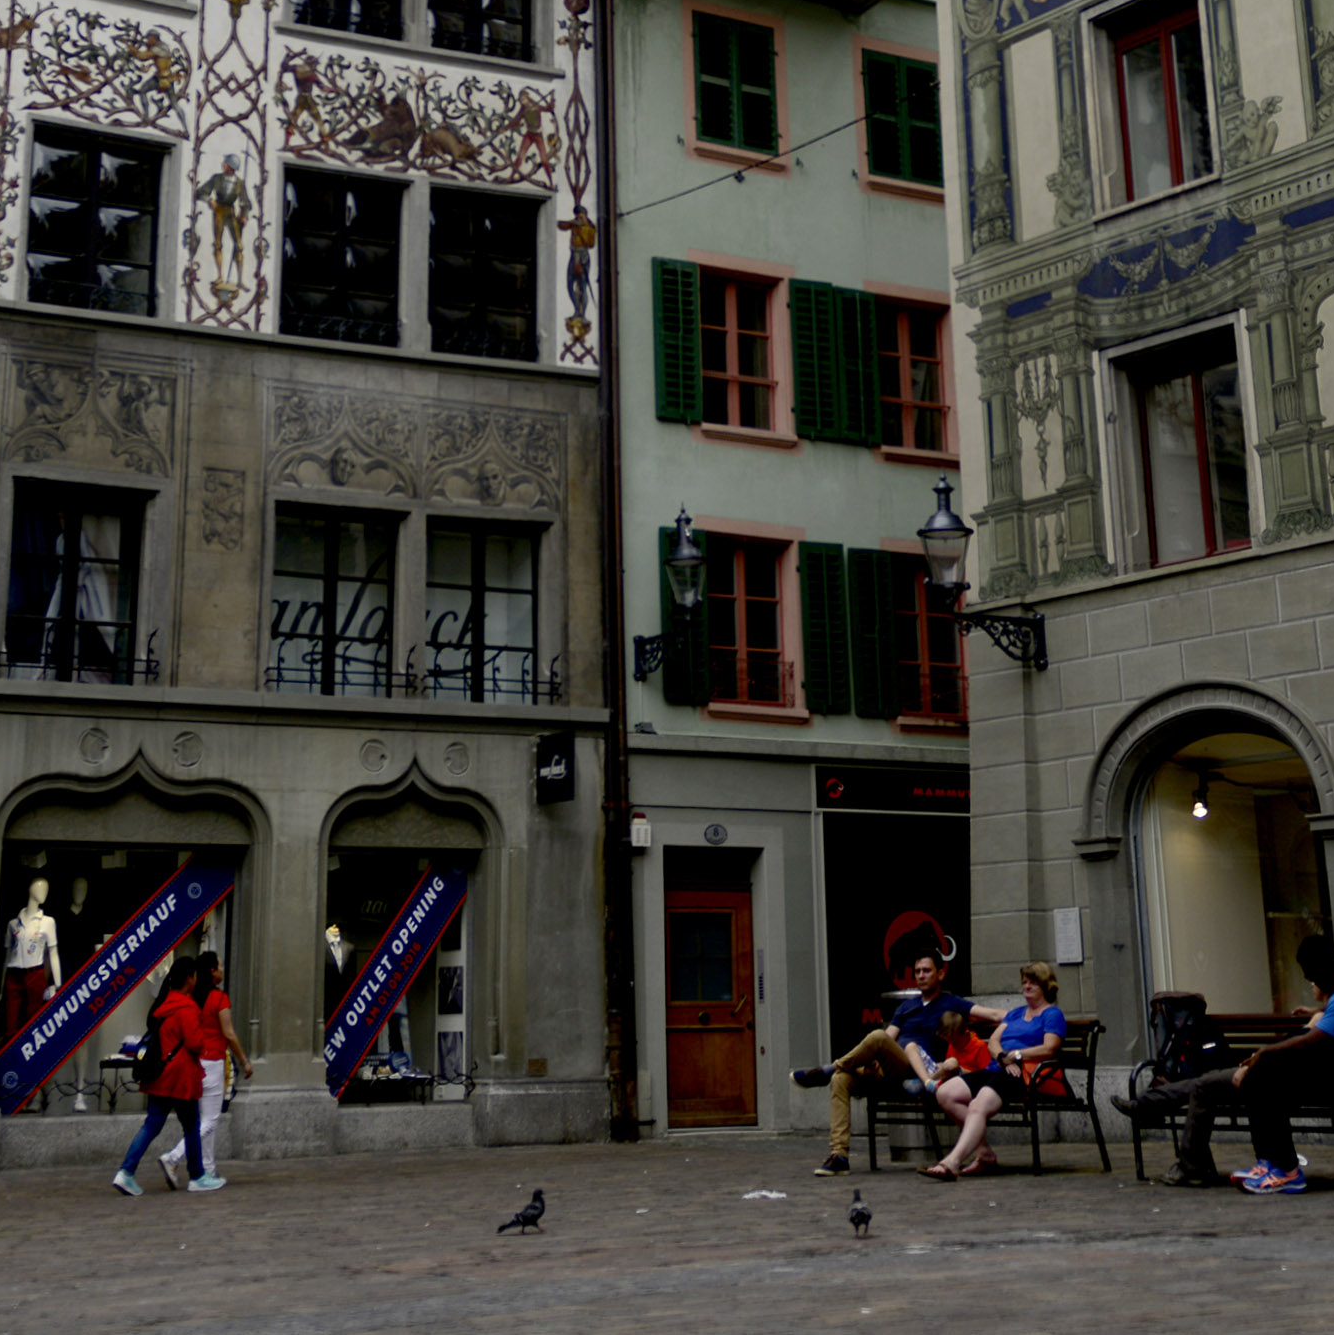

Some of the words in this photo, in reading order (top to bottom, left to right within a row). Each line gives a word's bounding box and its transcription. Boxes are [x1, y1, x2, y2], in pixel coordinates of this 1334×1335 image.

[20, 893, 178, 1062] RÄUMUNGSVERKAUF
[323, 1026, 346, 1066] EW
[345, 955, 393, 1027] OUTLET
[391, 876, 445, 955] OPENING
[365, 1006, 380, 1028] AM
[377, 941, 422, 1006] 01.09.2016
